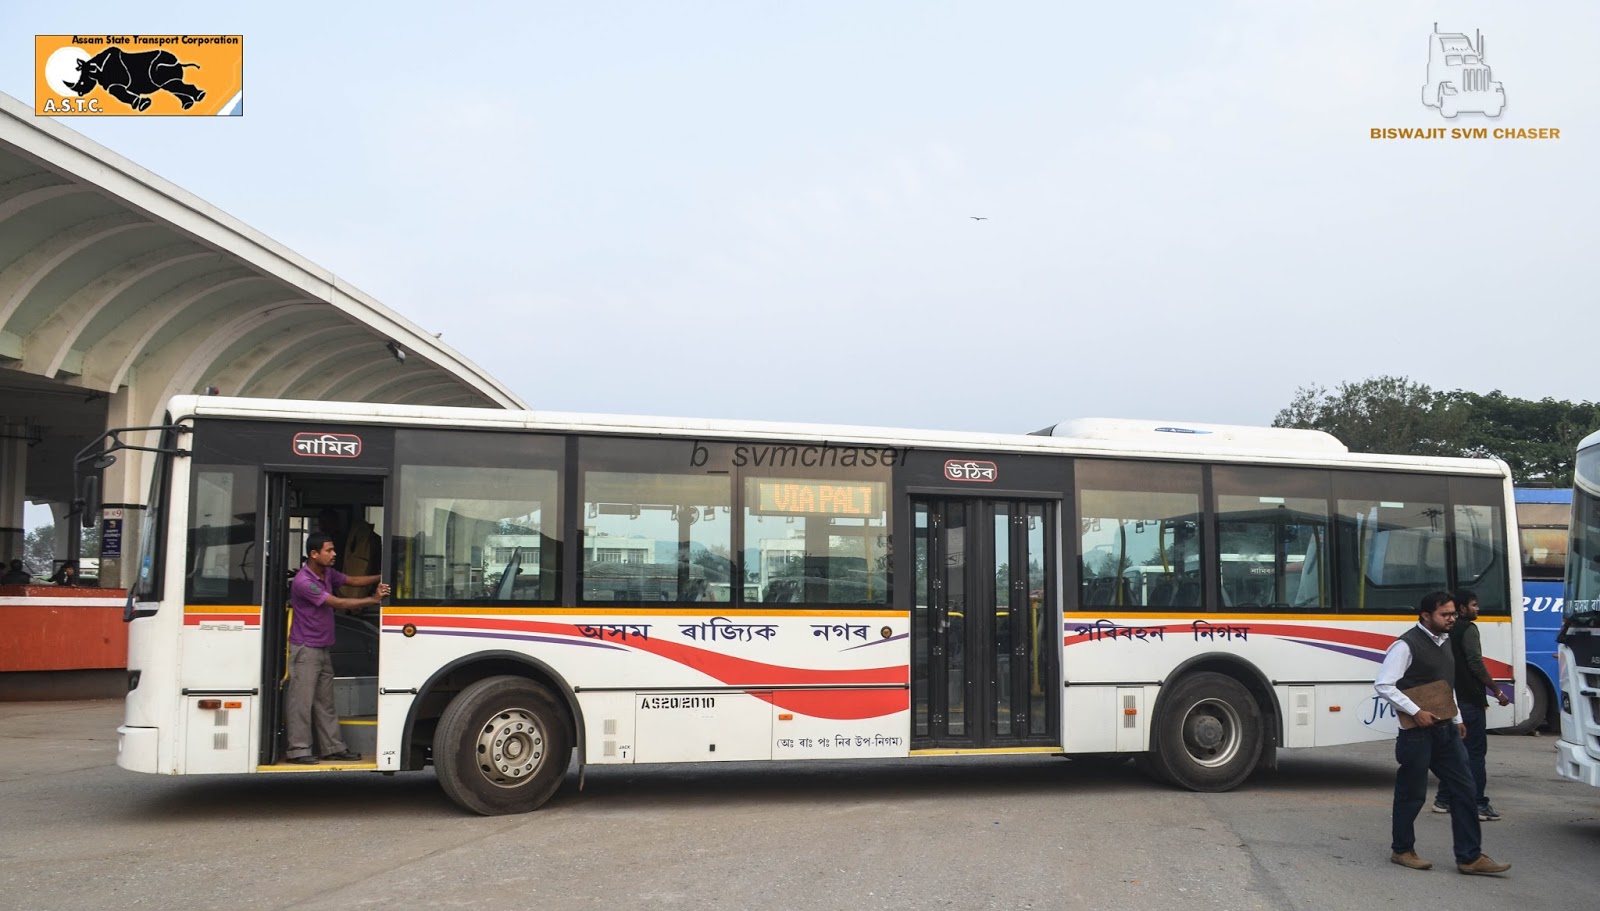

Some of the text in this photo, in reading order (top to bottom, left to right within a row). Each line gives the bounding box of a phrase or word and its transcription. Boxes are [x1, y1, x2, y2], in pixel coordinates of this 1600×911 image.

[774, 483, 815, 513] VIA
[574, 623, 653, 641] অসম
[810, 623, 871, 641] নগৰ
[1190, 619, 1251, 643] নিগম
